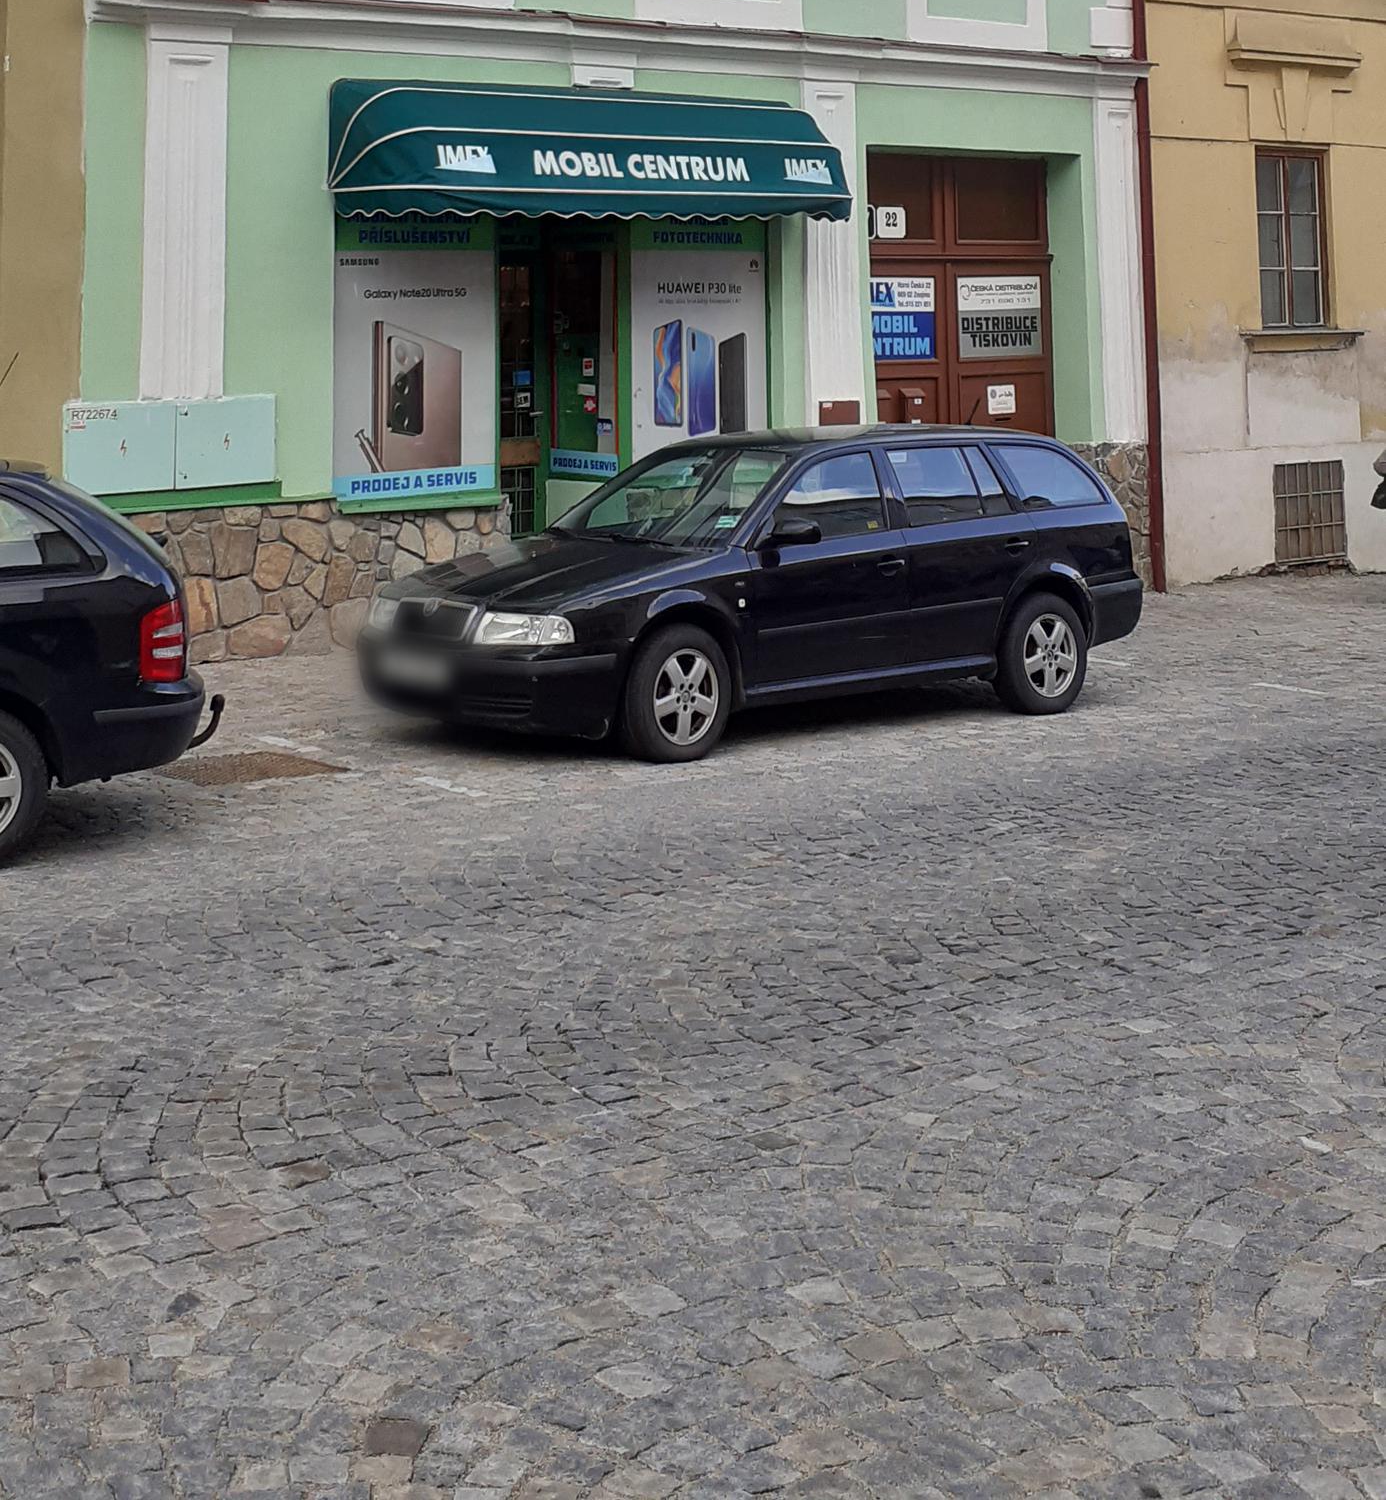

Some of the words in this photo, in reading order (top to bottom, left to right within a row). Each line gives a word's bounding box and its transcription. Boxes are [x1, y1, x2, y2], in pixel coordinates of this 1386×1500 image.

[533, 150, 625, 178] MOBIL
[627, 153, 751, 182] CENTRUM
[885, 212, 898, 227] 22
[653, 231, 743, 244] FOTOTECHNIKA
[339, 257, 380, 266] SAMSUNG
[363, 288, 398, 300] Galaxy
[432, 288, 453, 297] Ultra
[454, 287, 467, 297] 5G
[657, 283, 705, 294] HUAWEI
[708, 283, 726, 294] P30
[728, 283, 742, 294] lite
[870, 282, 894, 303] EX
[961, 316, 1038, 331] DISTRIBUCE
[873, 337, 930, 355] NTRUM
[970, 333, 1032, 348] TISKOVIN
[71, 409, 118, 420] R722674
[553, 457, 582, 468] PRODEJ
[583, 460, 589, 468] A
[590, 460, 617, 471] SERVIS
[351, 473, 411, 495] PRODEJ
[413, 474, 424, 489] A
[426, 471, 477, 487] SERVIS
